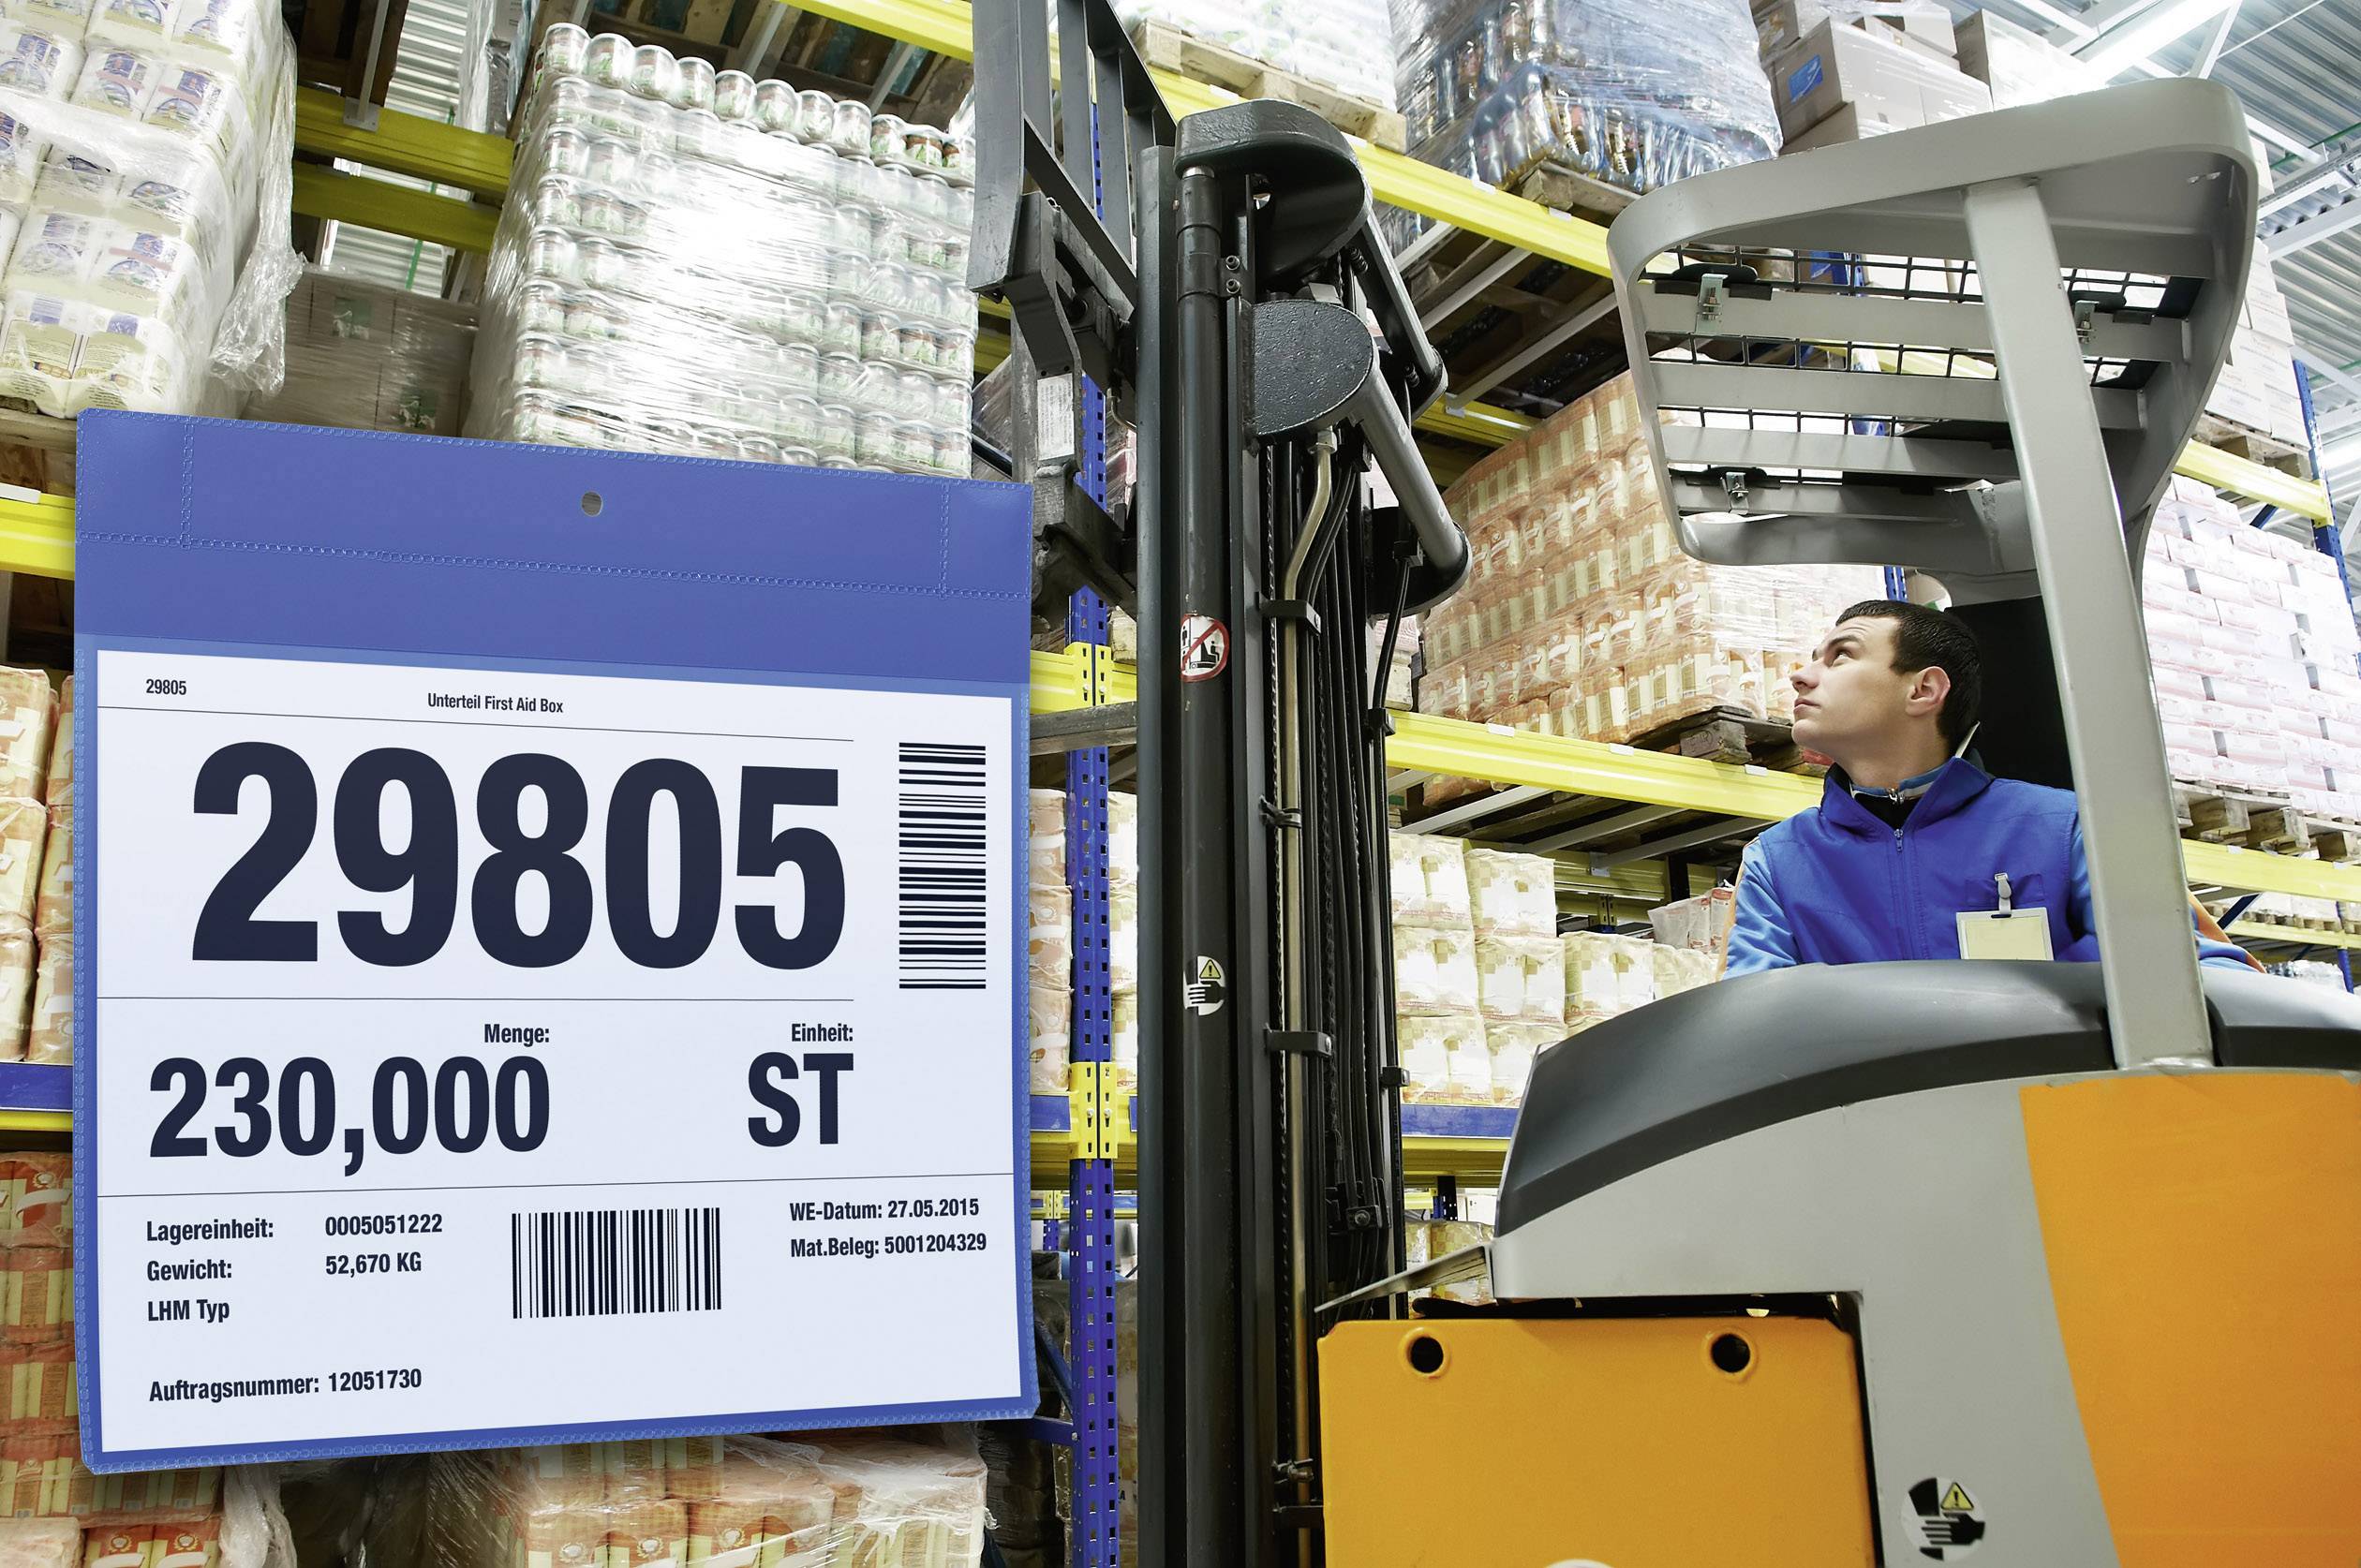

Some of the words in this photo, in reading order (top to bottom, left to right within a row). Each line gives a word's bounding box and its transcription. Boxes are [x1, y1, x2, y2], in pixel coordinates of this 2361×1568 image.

[146, 679, 186, 695] 29805
[428, 693, 480, 708] Unterteil
[485, 696, 512, 710] First
[516, 698, 536, 711] Aid
[541, 699, 563, 713] Box
[192, 741, 846, 969] 29805
[484, 1024, 549, 1047] Menge:
[792, 1023, 853, 1042] Einheit:
[749, 1052, 853, 1146] ST
[150, 1056, 549, 1176] 230,000
[790, 1202, 882, 1220] WE-Datum:
[888, 1198, 979, 1218] 27.05.2015
[147, 1218, 273, 1245] Lagereinheit:
[326, 1214, 442, 1235] 0005051222
[791, 1237, 879, 1259] Mat.Beleg:
[885, 1233, 987, 1253] 5001204329
[147, 1259, 231, 1281] Gewicht:
[326, 1254, 390, 1278] 52,670
[397, 1251, 421, 1272] KG
[148, 1300, 189, 1321] LHM
[197, 1299, 230, 1323] Typ
[150, 1378, 319, 1403] Auftragsnummer:
[329, 1368, 422, 1391] 12051730
